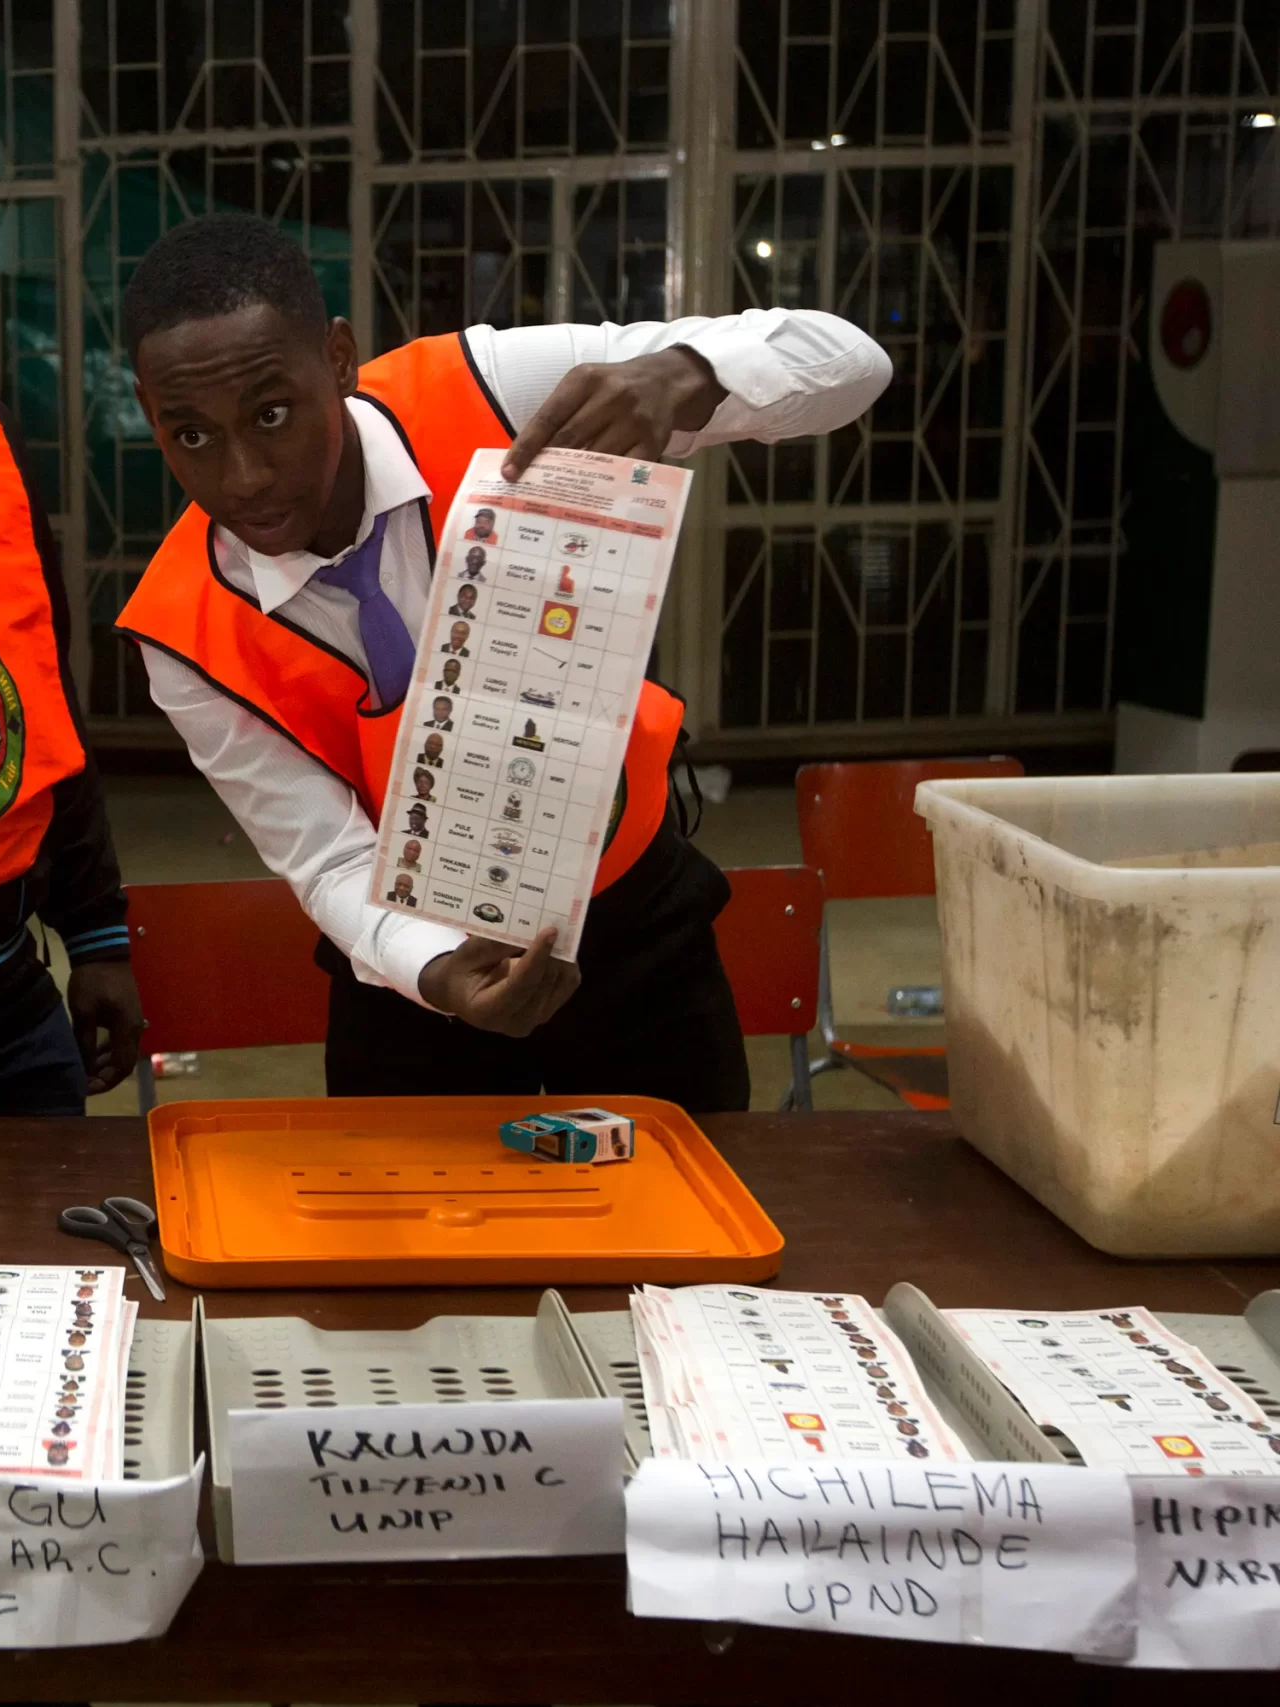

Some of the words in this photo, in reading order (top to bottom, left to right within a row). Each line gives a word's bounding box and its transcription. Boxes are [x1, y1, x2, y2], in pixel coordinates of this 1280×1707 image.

[307, 1428, 534, 1468] KAUNDA
[534, 1466, 566, 1487] C
[697, 1463, 1043, 1525] HICHILEMA
[330, 1508, 453, 1534] UNIP
[784, 1577, 940, 1622] UPND
